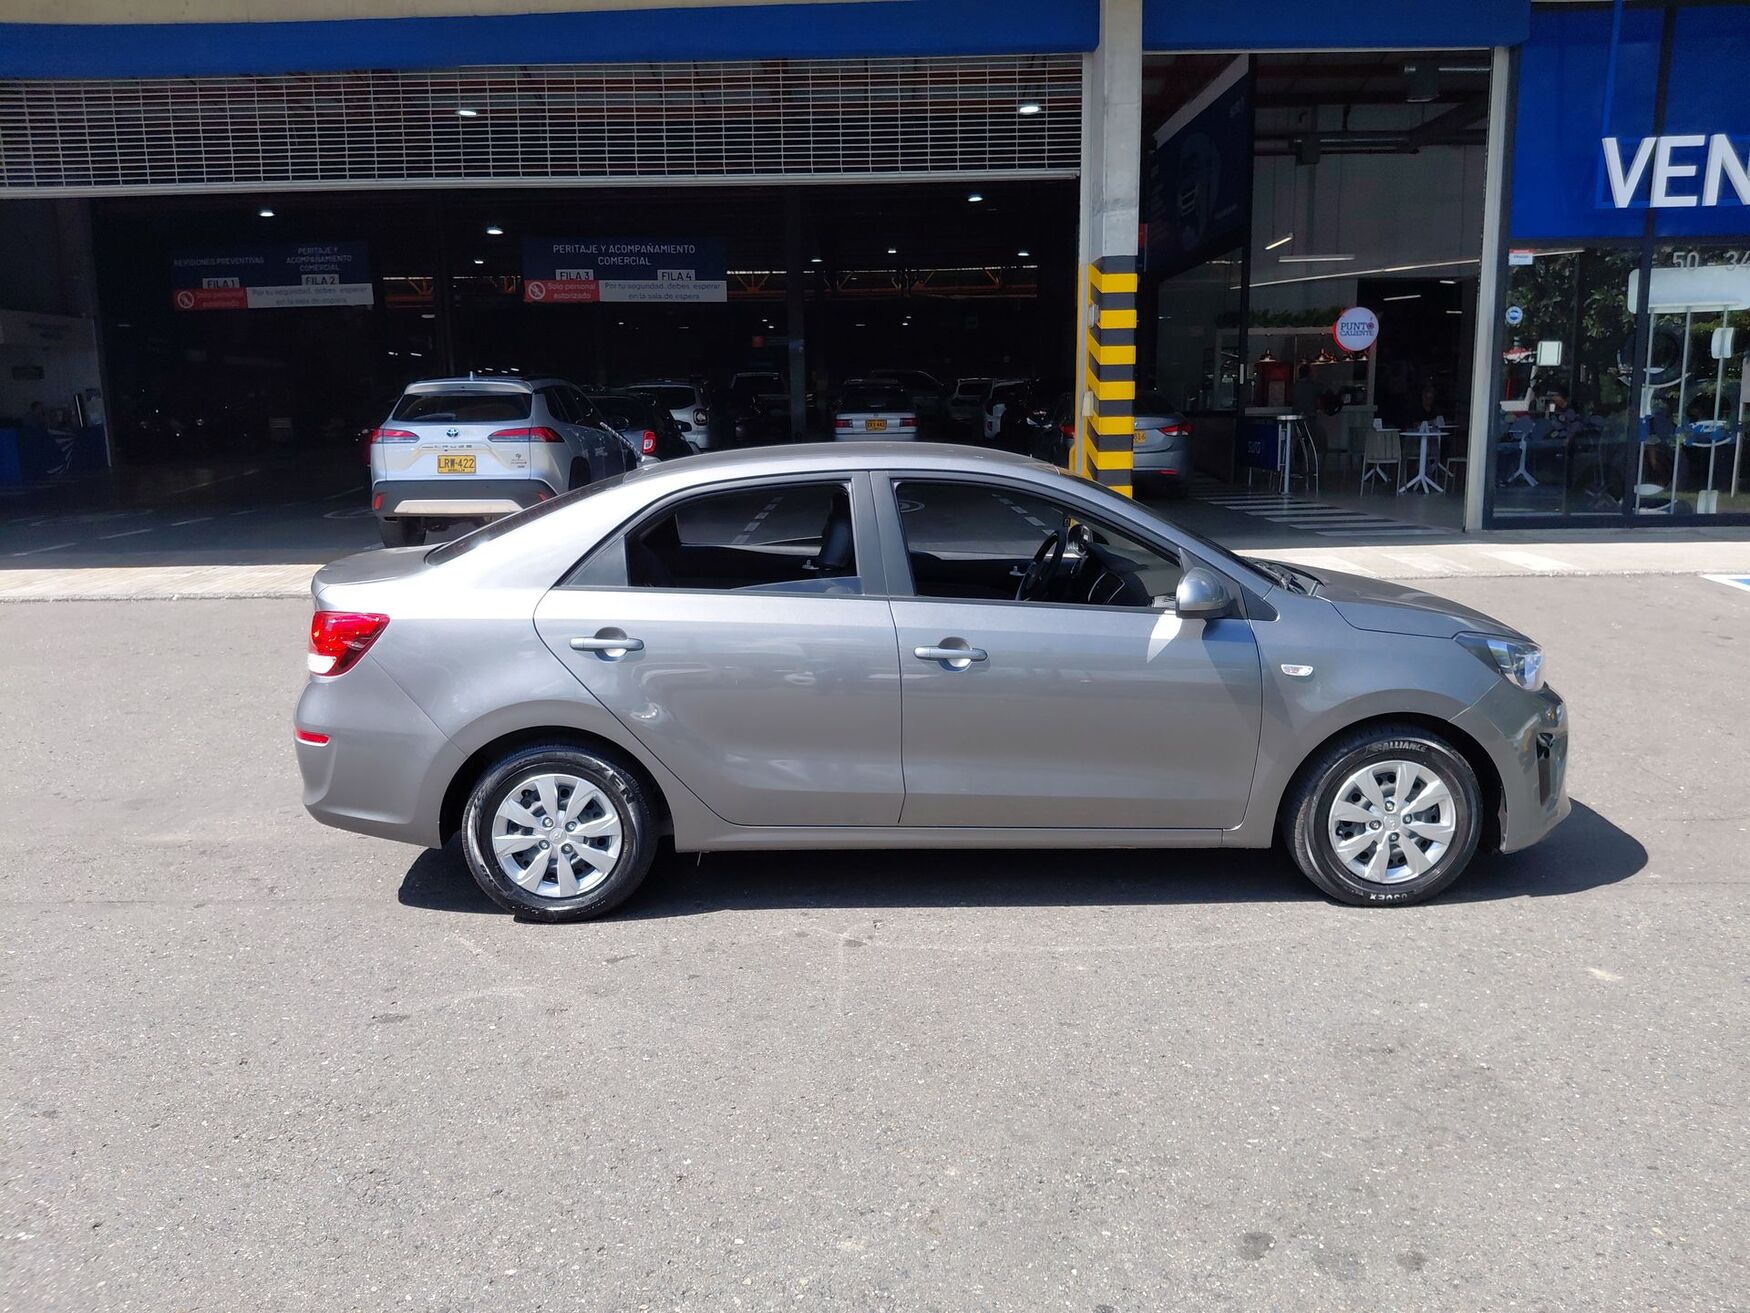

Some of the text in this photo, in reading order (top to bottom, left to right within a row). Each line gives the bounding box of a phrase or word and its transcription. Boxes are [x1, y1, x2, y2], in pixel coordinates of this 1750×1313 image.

[553, 242, 696, 254] PERITAJE Y ACOMPAÑAMIENTO
[598, 256, 652, 265] COMERCIAL
[1673, 251, 1699, 270] 50
[560, 271, 590, 280] FILA 3
[661, 271, 692, 281] FILA 4
[207, 280, 230, 288] FILA
[306, 276, 336, 285] FILA 2
